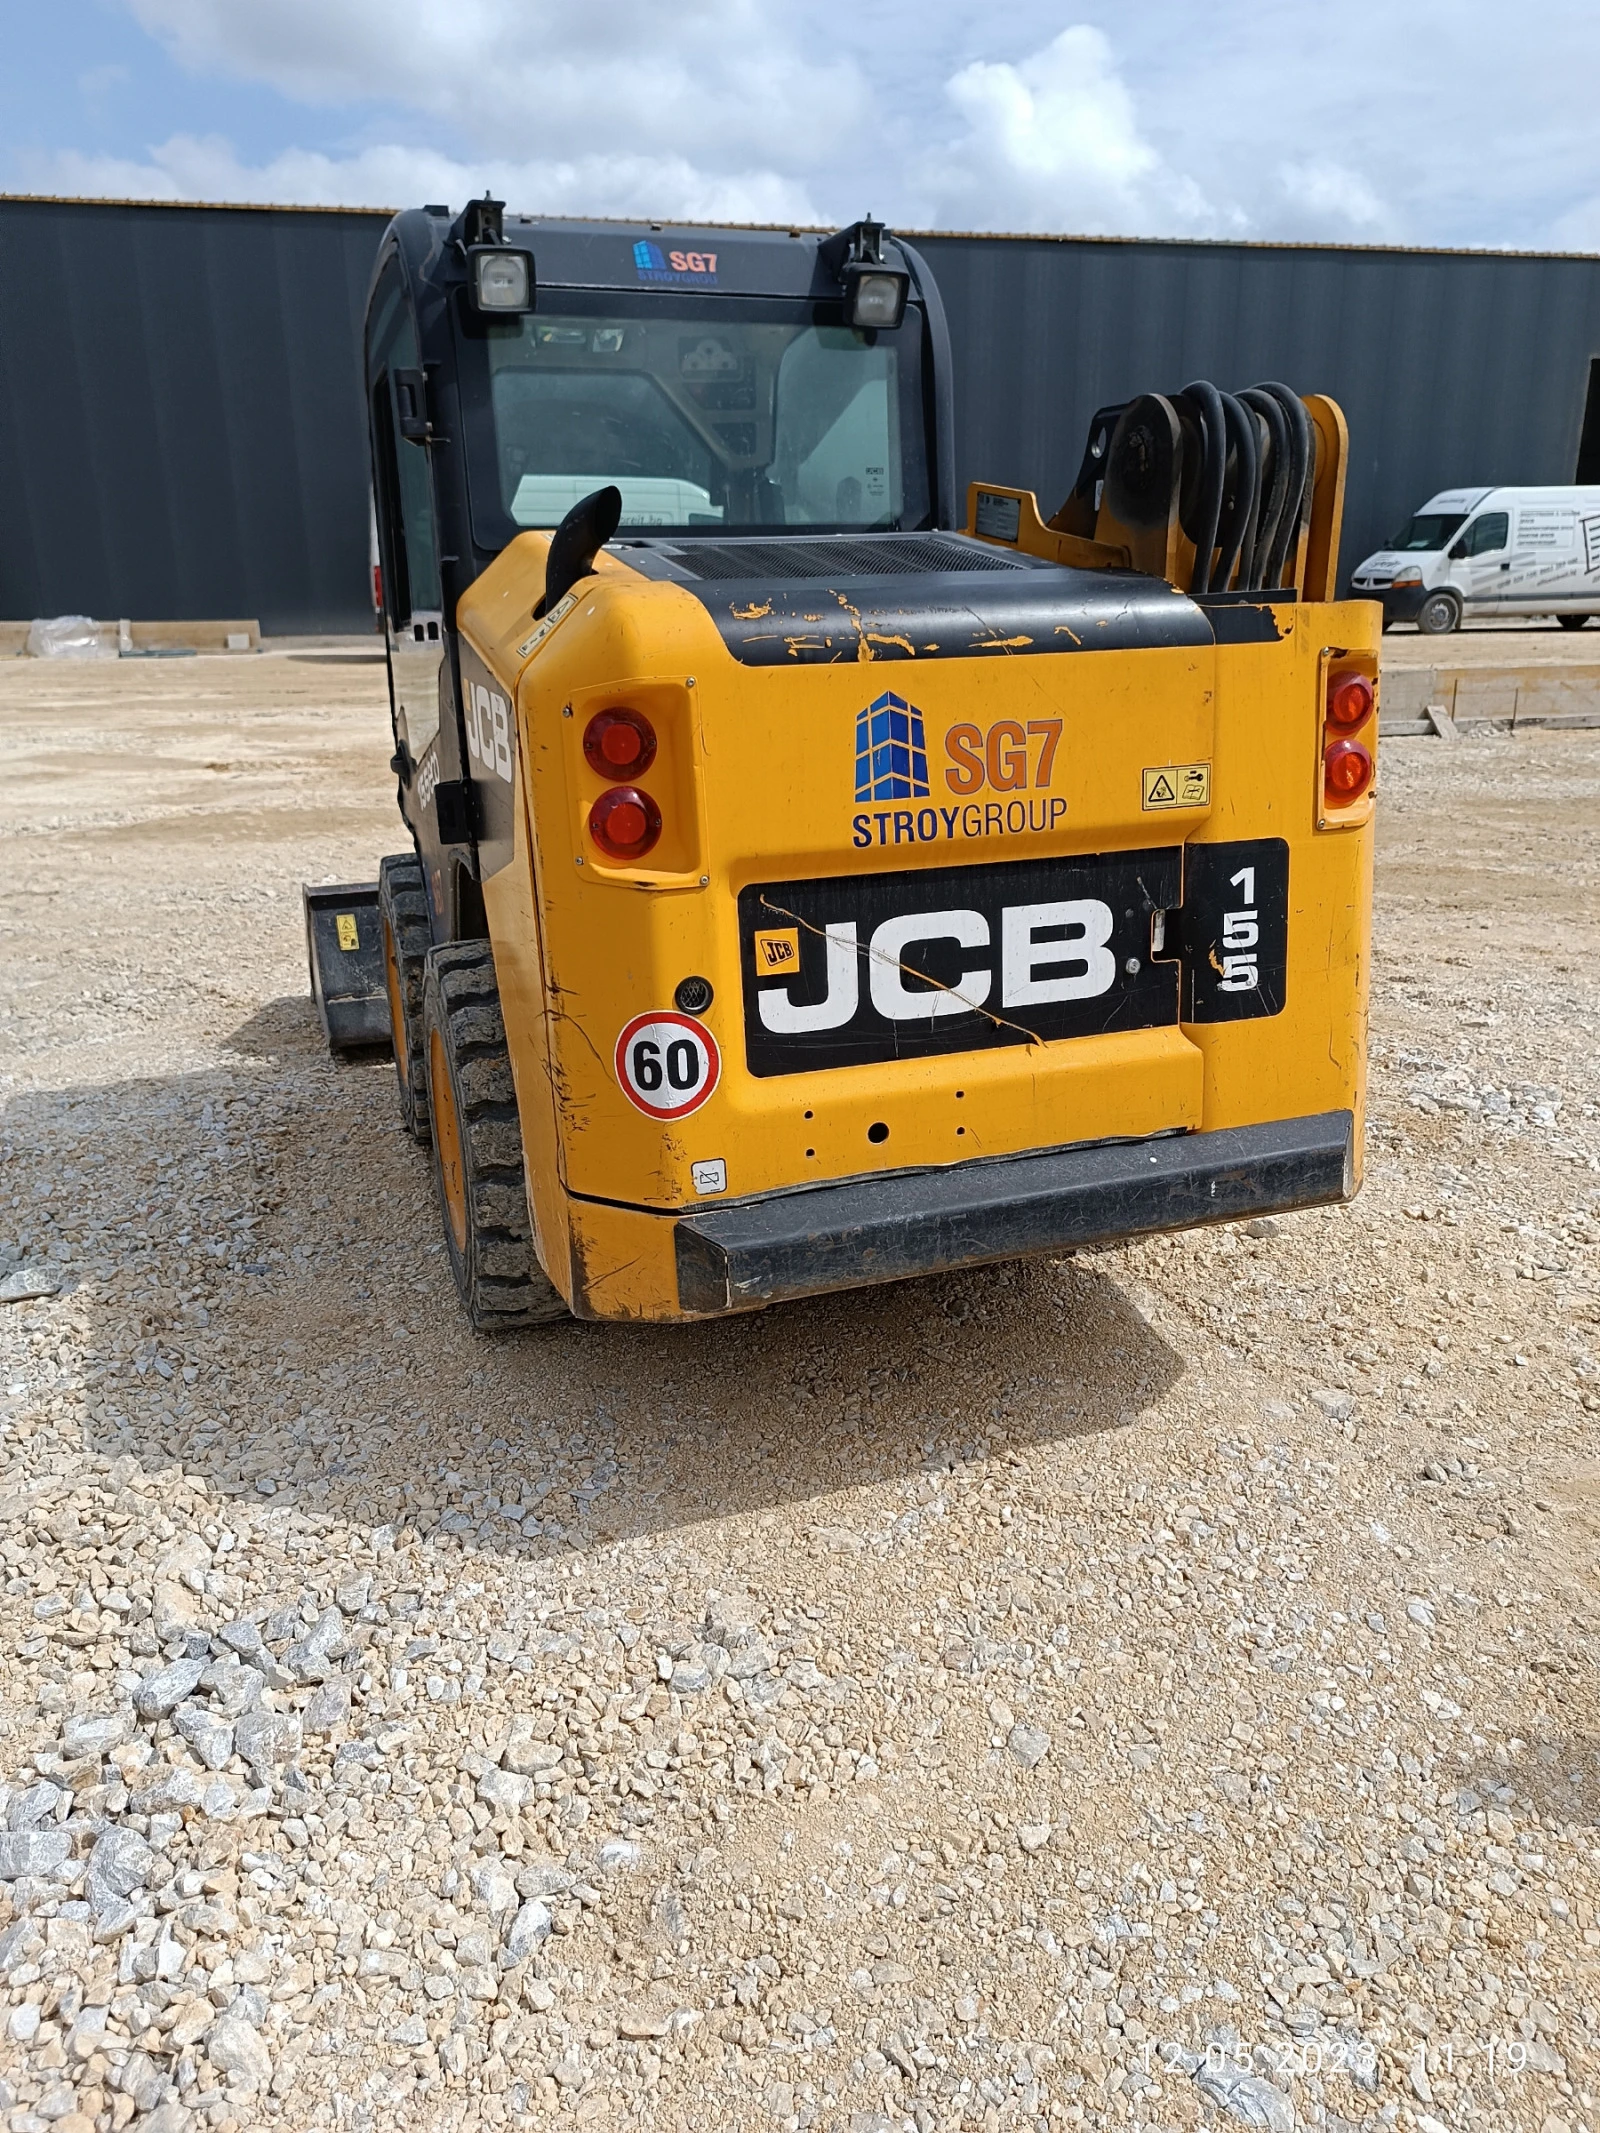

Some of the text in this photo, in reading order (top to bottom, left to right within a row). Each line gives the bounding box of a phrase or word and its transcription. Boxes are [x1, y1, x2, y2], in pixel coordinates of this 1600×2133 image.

[669, 250, 718, 273] SG7
[467, 681, 512, 784] JCB
[944, 718, 1065, 795] SG7
[852, 797, 1068, 848] STROYGROUP
[758, 898, 1116, 1034] JCB
[767, 941, 792, 963] JCB
[633, 1038, 699, 1091] 60
